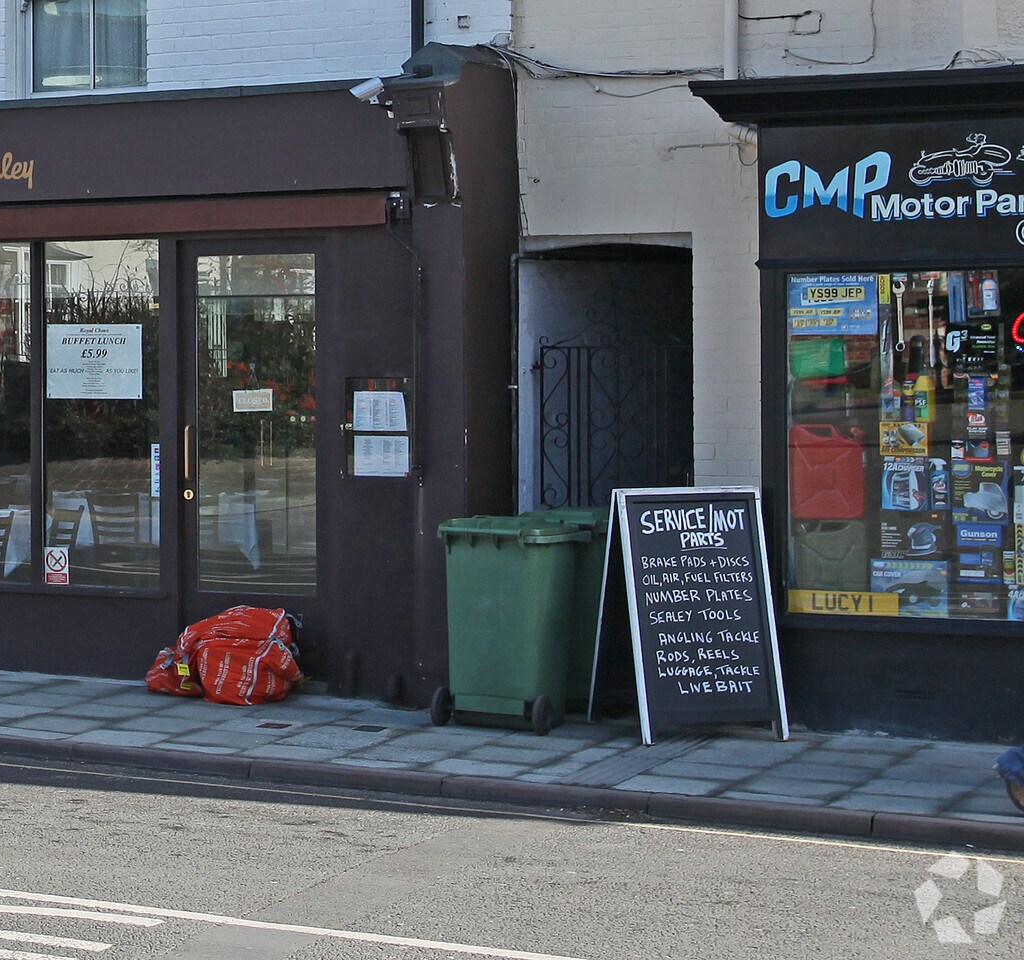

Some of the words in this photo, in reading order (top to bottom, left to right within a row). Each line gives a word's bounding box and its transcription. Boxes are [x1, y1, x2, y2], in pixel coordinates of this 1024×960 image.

[764, 150, 892, 219] CMP
[871, 194, 971, 221] Motor
[810, 288, 838, 298] YS99
[841, 288, 862, 298] JEP
[61, 337, 96, 345] BUFFET
[97, 337, 127, 345] LUNCH
[81, 348, 108, 359] £5.99
[680, 532, 725, 548] PARTS
[960, 529, 997, 538] Gunson
[641, 556, 677, 569] BRAKE
[680, 555, 706, 567] PADS
[714, 571, 753, 583] FILTERS
[883, 570, 901, 578] COVER
[645, 589, 701, 606] NUMBER
[706, 589, 753, 602] PLATES
[649, 610, 692, 625] SEALEY
[698, 608, 742, 621] TOOLS
[658, 631, 713, 646] ANGLING
[717, 629, 759, 643] TACKLE
[698, 648, 740, 660] REELS
[678, 681, 712, 694] LIVE
[715, 680, 753, 693] BAIT
